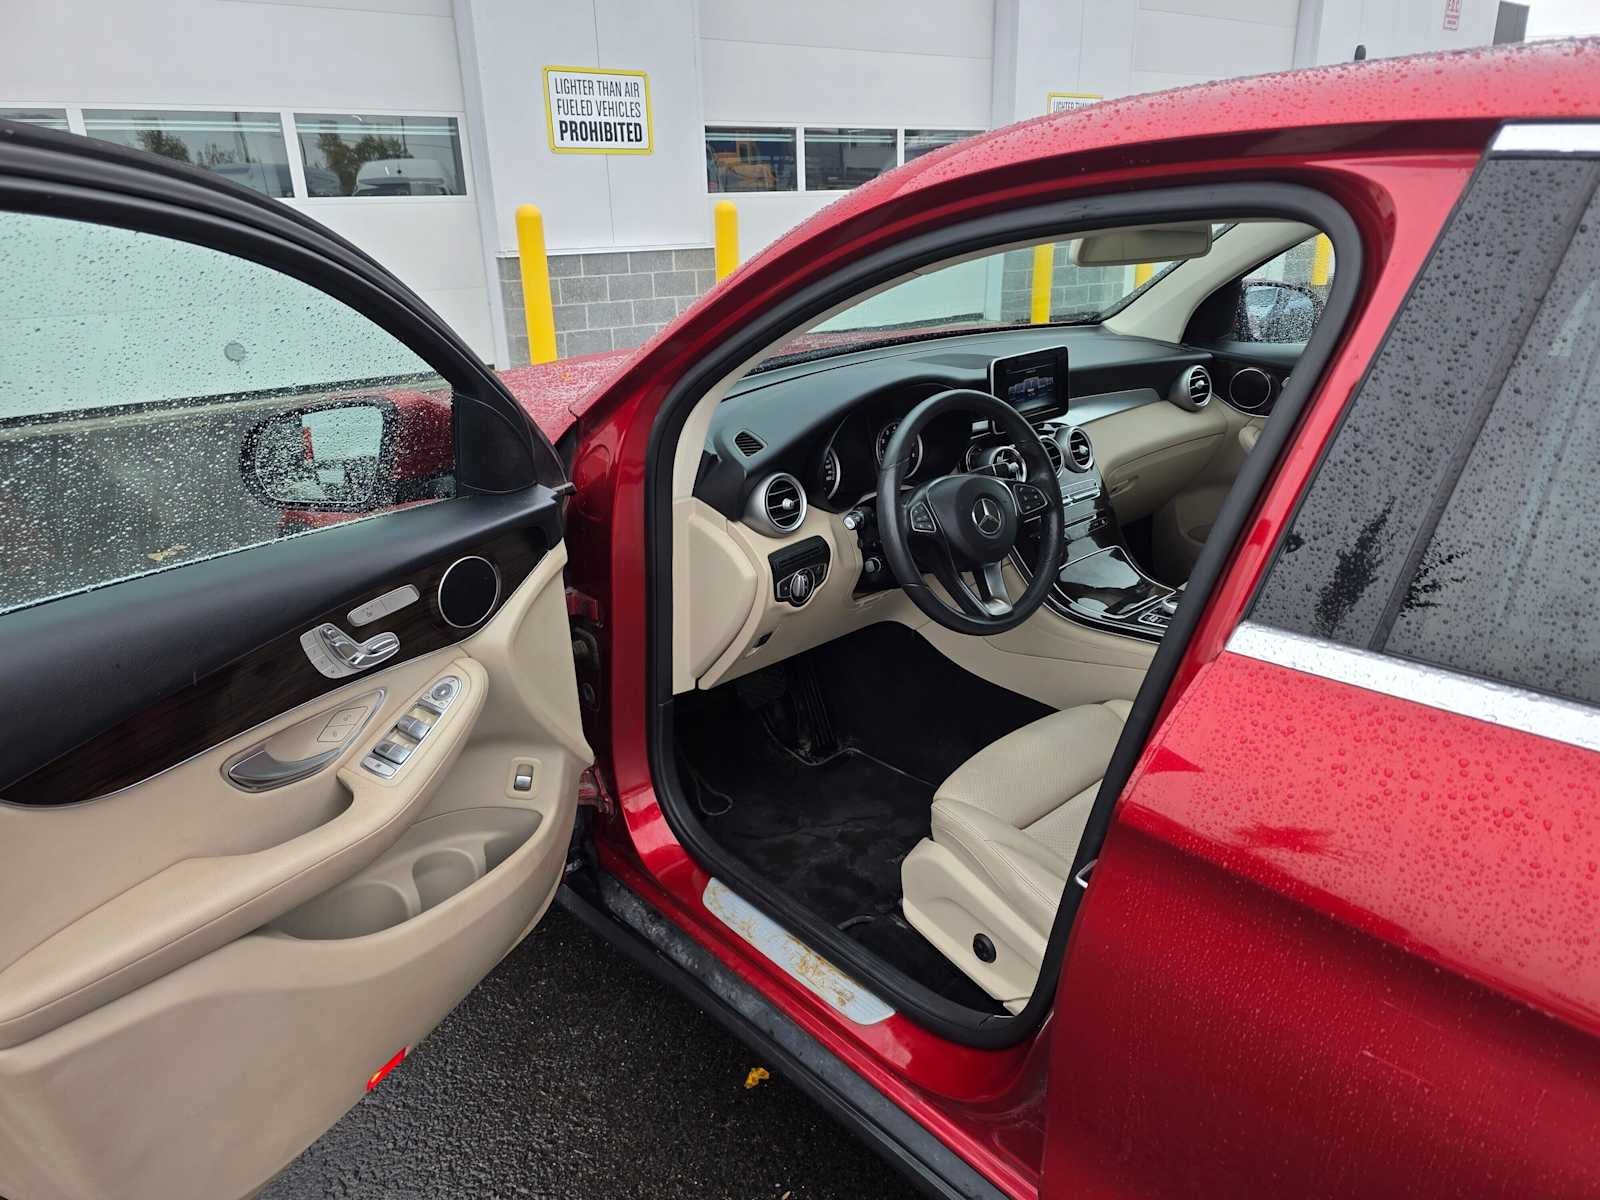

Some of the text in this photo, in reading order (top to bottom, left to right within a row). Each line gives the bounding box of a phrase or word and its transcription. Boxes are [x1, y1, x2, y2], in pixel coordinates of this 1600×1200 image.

[555, 78, 640, 98] LIGHTER THAN AIR
[557, 99, 641, 118] FUELED VEHICLES
[559, 120, 643, 142] PROHIBITED
